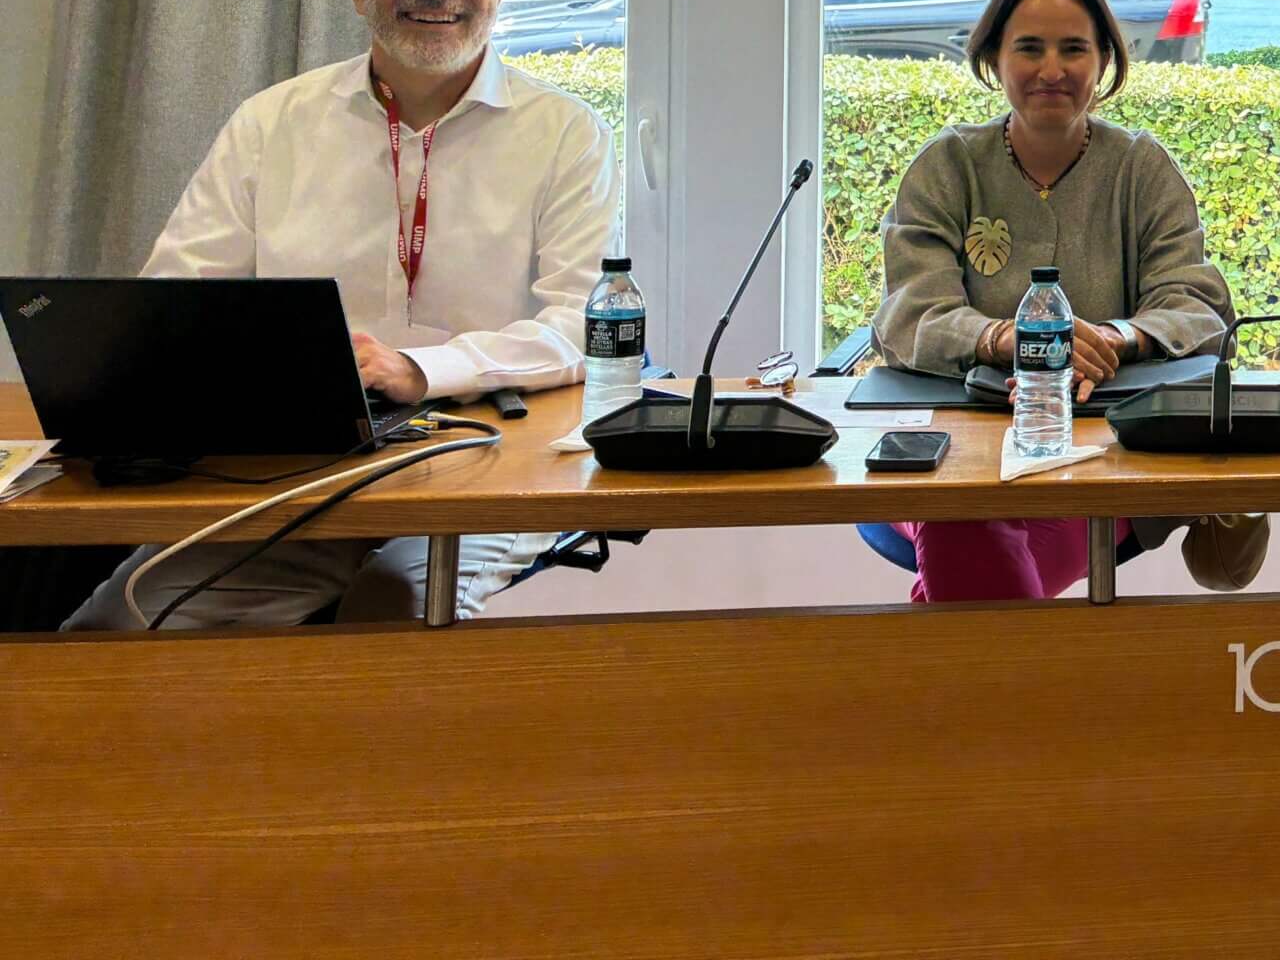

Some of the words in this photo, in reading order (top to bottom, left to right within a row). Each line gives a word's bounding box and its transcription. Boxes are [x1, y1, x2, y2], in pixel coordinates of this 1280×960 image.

[390, 123, 399, 151] UIMP
[412, 225, 424, 254] UIMP
[1020, 341, 1071, 357] BEZOYA
